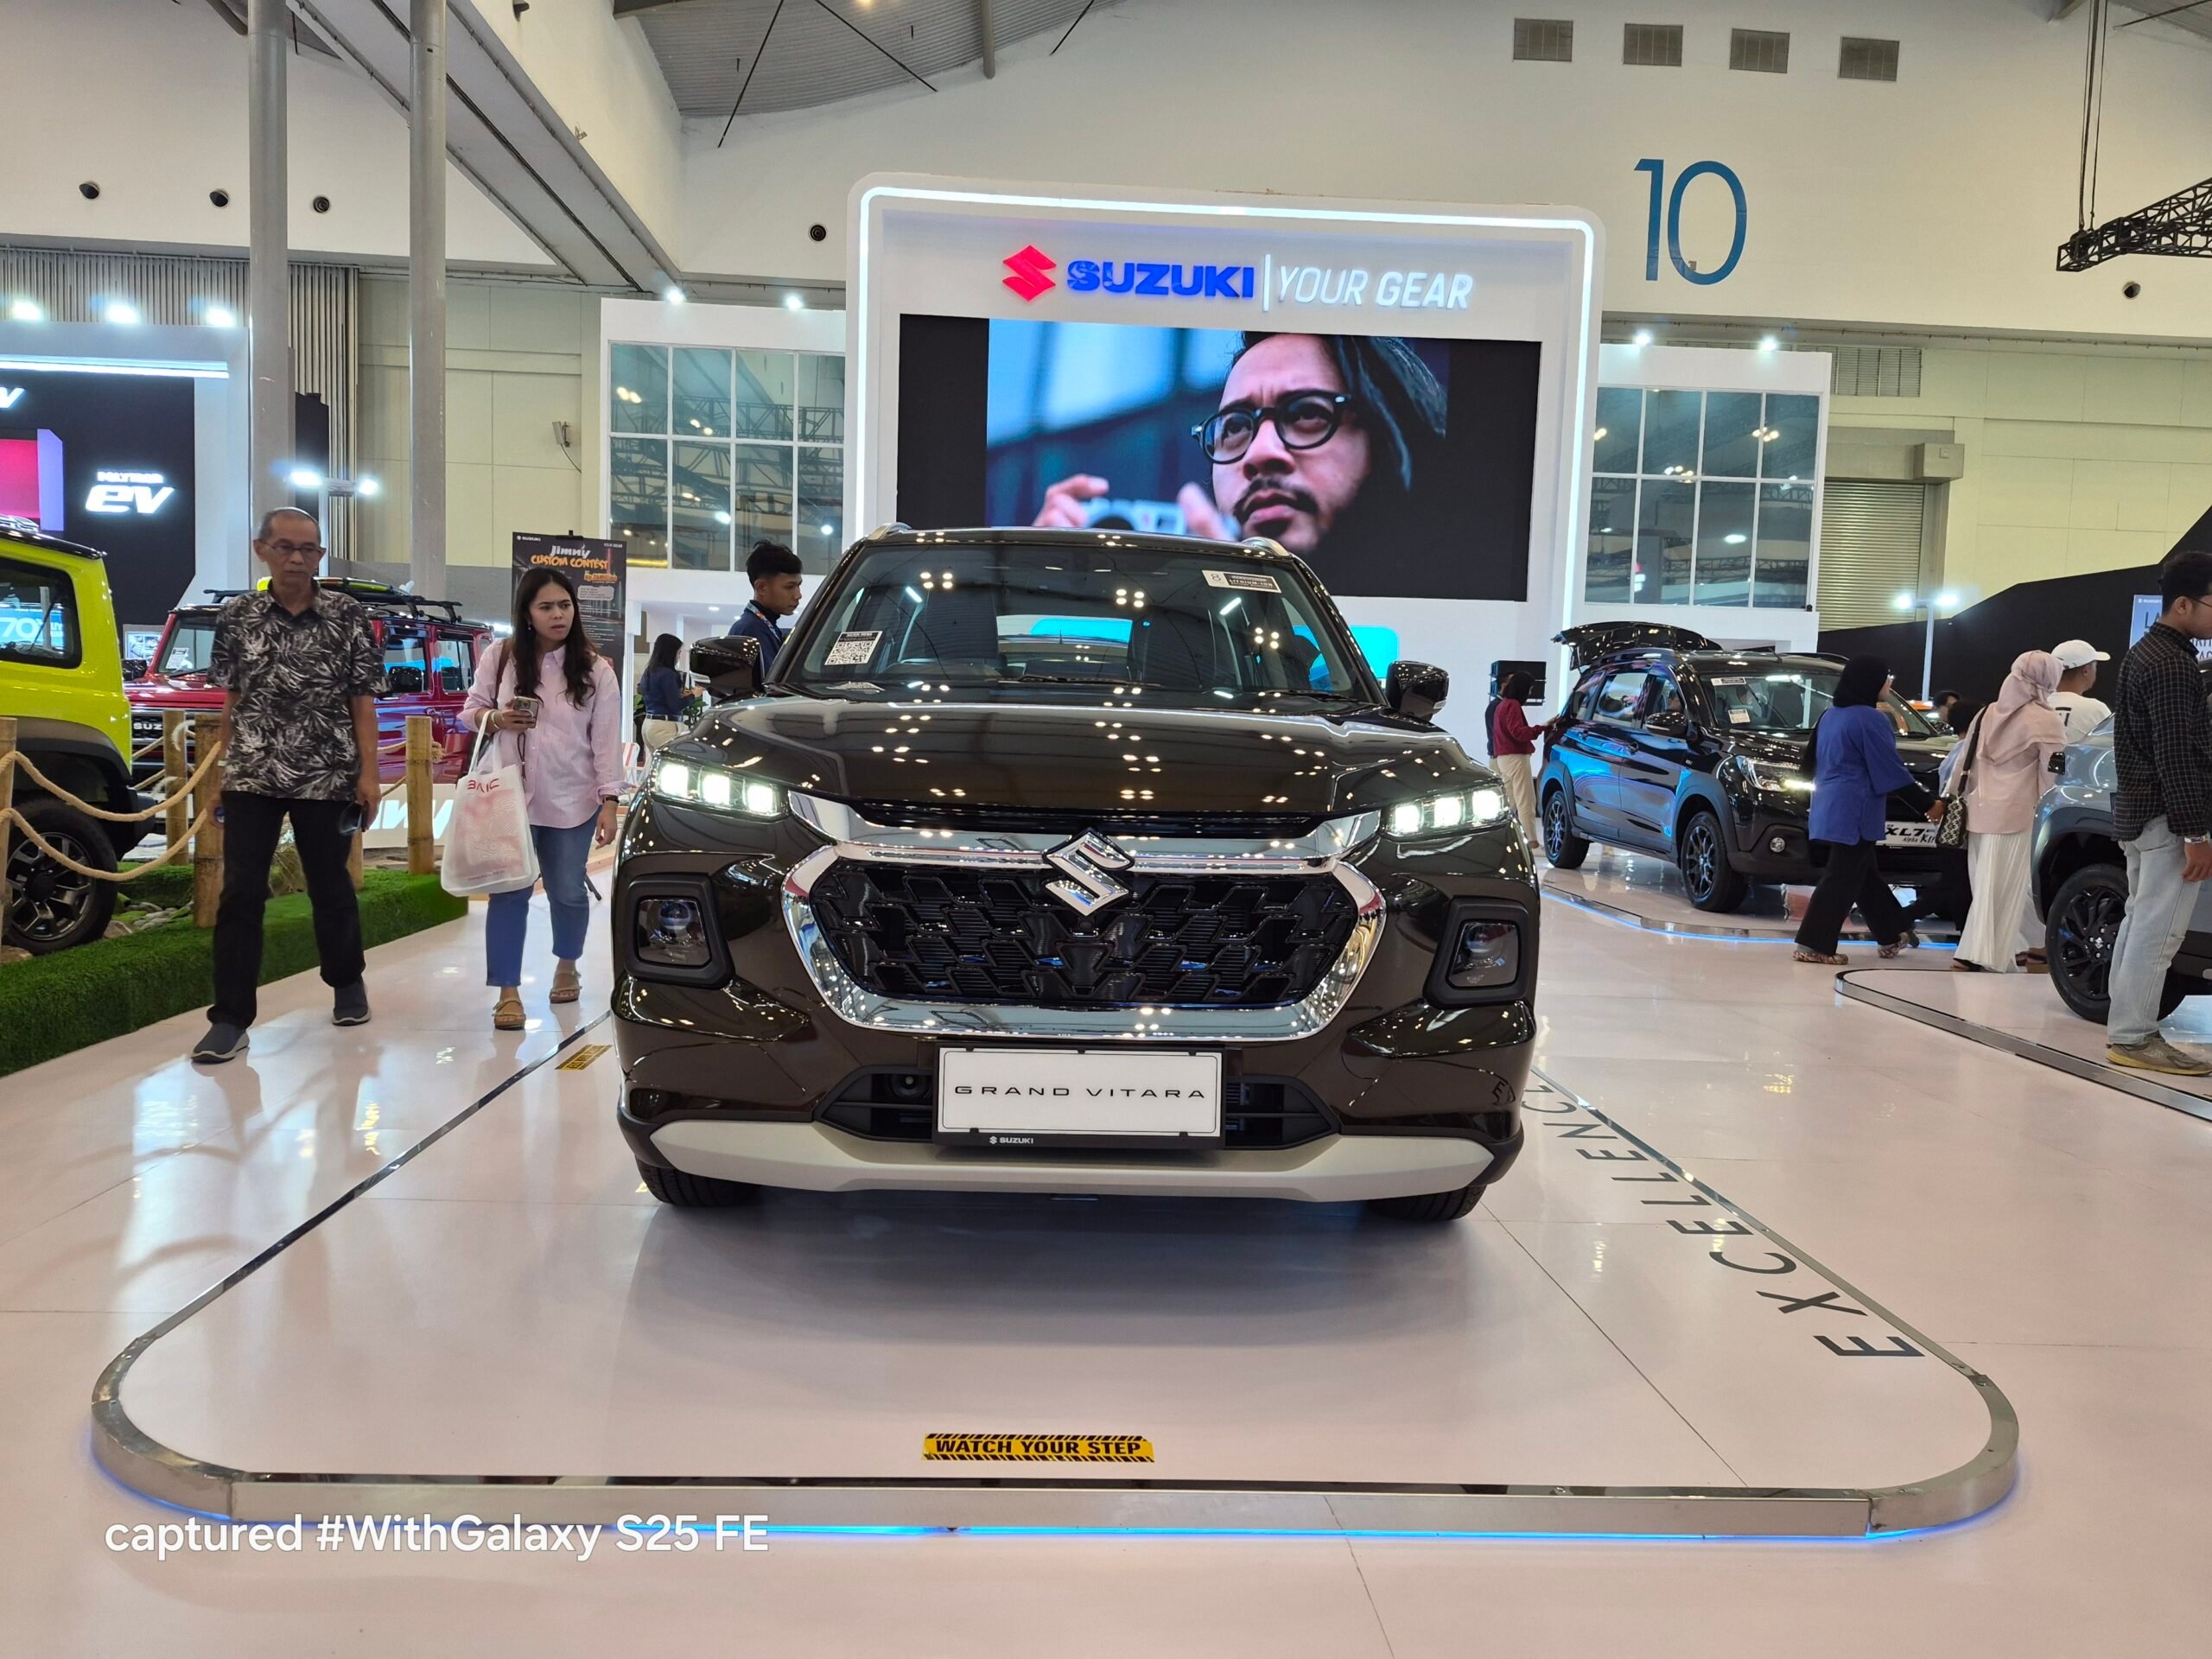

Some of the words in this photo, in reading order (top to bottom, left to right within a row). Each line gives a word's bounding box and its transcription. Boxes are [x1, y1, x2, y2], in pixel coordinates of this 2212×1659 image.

[1634, 158, 1747, 285] 10
[1066, 260, 1255, 298] SUZUKI
[1278, 265, 1369, 306] YOUR
[1376, 271, 1473, 309] GEAR
[531, 555, 568, 566] CUSTOM
[570, 557, 609, 569] CONTEST
[955, 1085, 1071, 1096] GRAND
[1086, 1088, 1205, 1099] VITARA
[999, 1136, 1034, 1145] SUZUKI
[936, 1440, 1013, 1453] WATCH
[1020, 1440, 1079, 1454] YOUR
[1088, 1442, 1141, 1455] STEP
